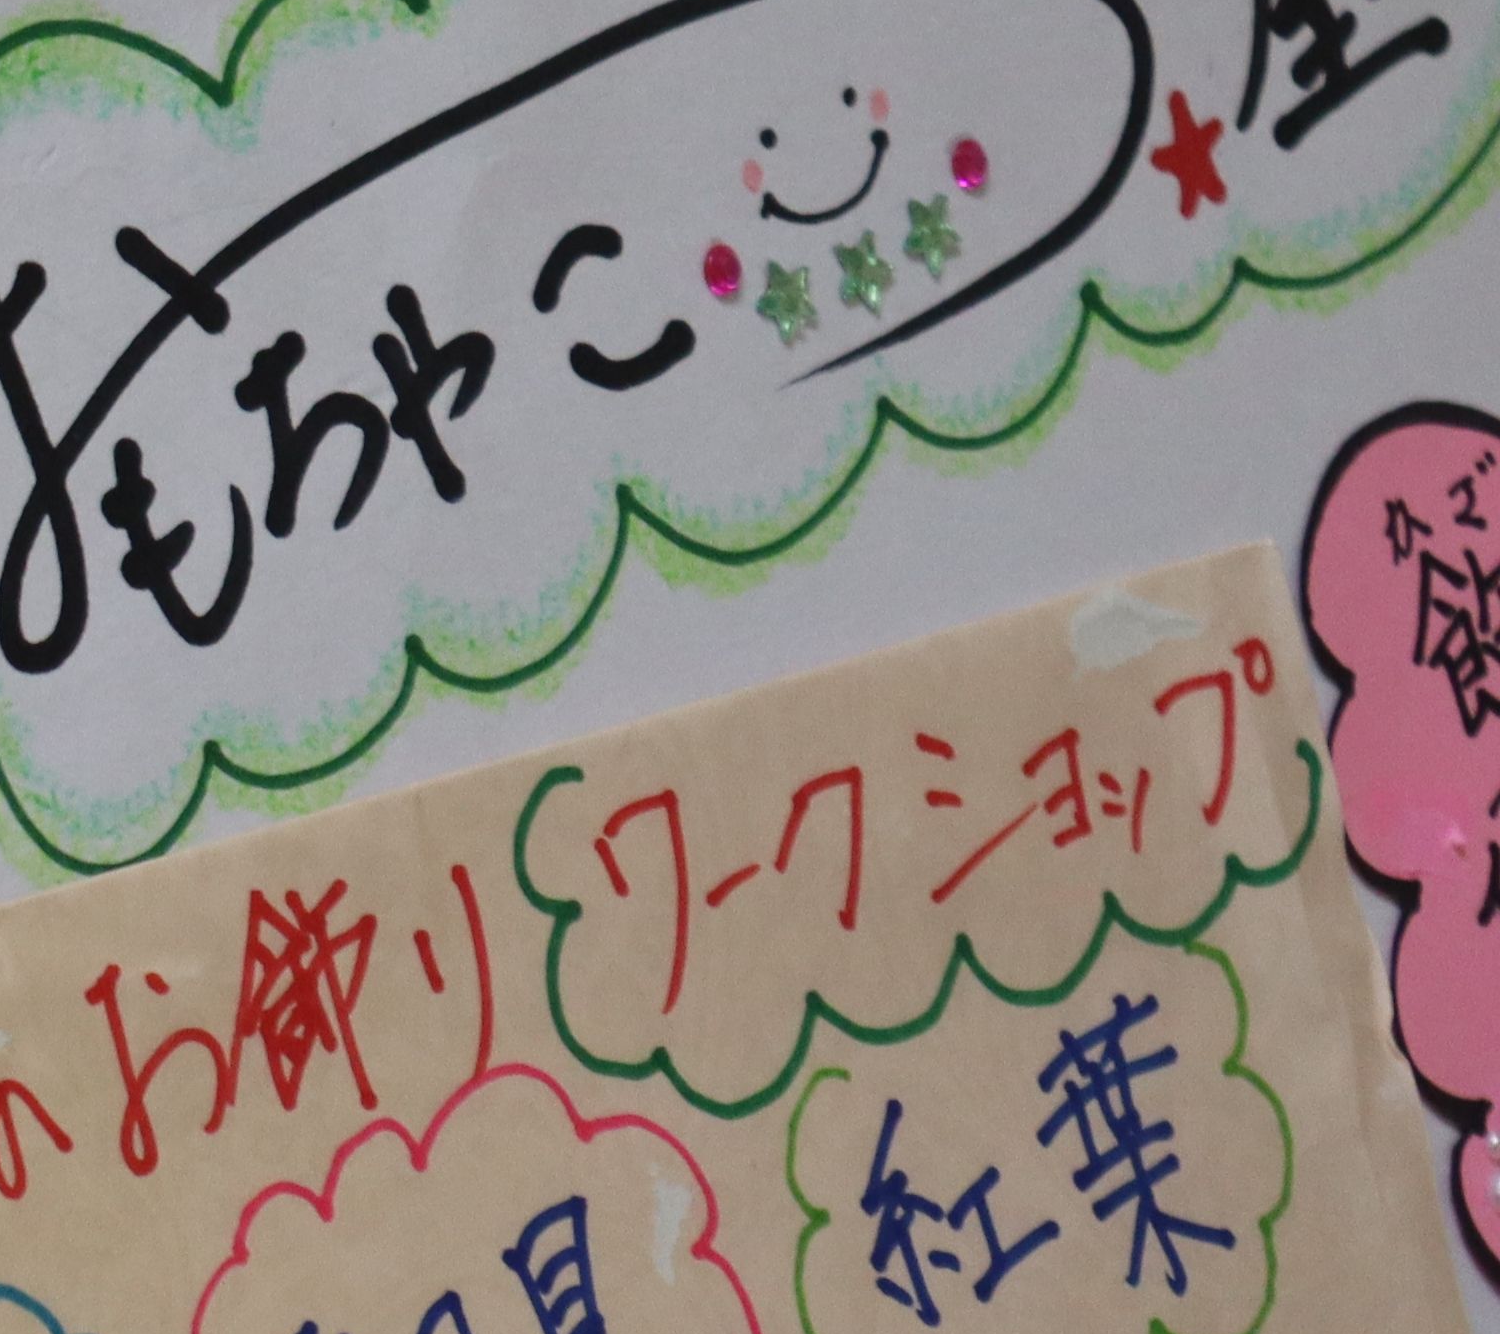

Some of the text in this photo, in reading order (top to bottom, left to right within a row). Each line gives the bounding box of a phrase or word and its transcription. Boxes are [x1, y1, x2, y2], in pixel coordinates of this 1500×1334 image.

[593, 637, 1275, 1013] ワークショップ
[861, 996, 1236, 1327] 紅葉
